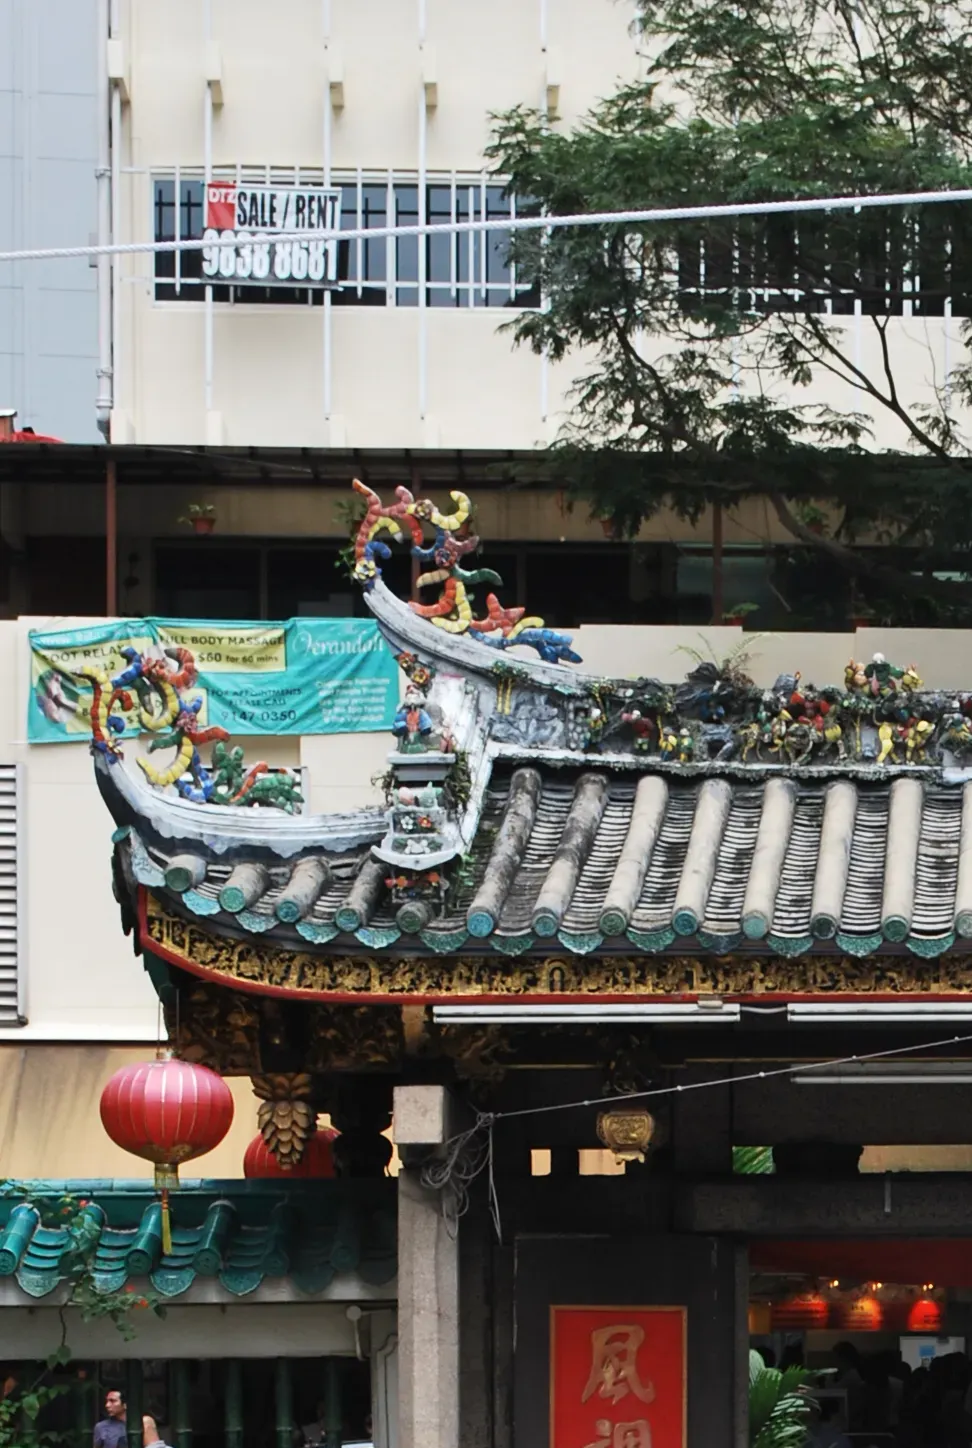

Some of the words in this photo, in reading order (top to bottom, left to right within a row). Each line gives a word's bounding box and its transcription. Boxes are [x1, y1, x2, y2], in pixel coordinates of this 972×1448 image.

[208, 187, 236, 204] DTZ
[237, 191, 277, 228] SALE
[282, 193, 290, 229] /
[295, 194, 339, 230] RENT
[202, 229, 270, 279] 9838
[274, 234, 338, 281] 8681
[190, 635, 224, 646] BODY
[228, 635, 285, 646] MASSAGE
[198, 652, 223, 662] $60
[226, 655, 239, 663] for
[242, 655, 255, 663] 60
[256, 654, 279, 663] mins
[221, 710, 256, 721] 9147
[261, 709, 297, 721] 0350
